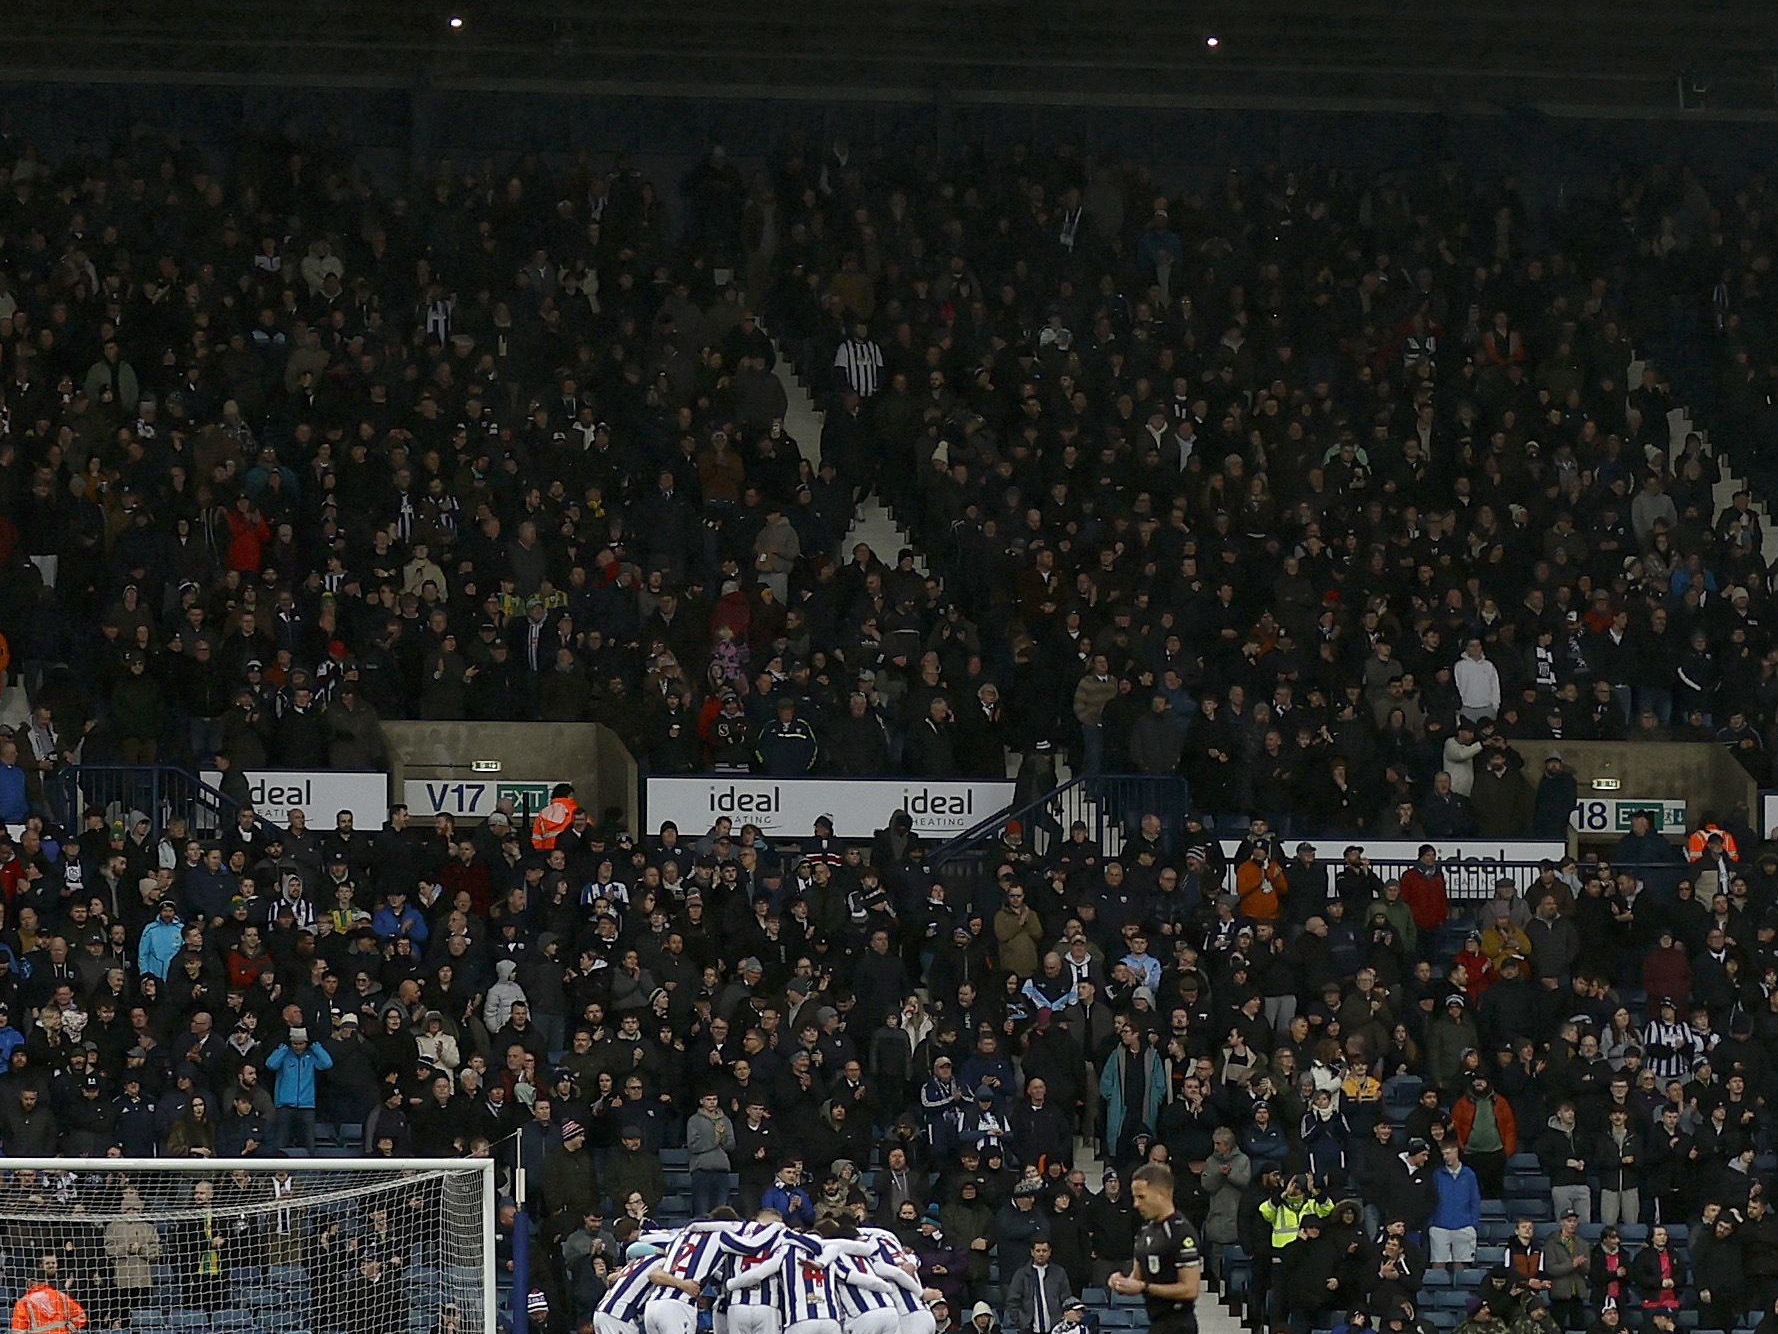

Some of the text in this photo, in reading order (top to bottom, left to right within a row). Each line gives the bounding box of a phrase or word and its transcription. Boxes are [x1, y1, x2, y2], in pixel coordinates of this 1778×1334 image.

[250, 779, 311, 806] deal
[426, 783, 486, 813] V17
[709, 785, 780, 813] ideal
[903, 788, 973, 815] ideal
[1573, 801, 1608, 830] 18
